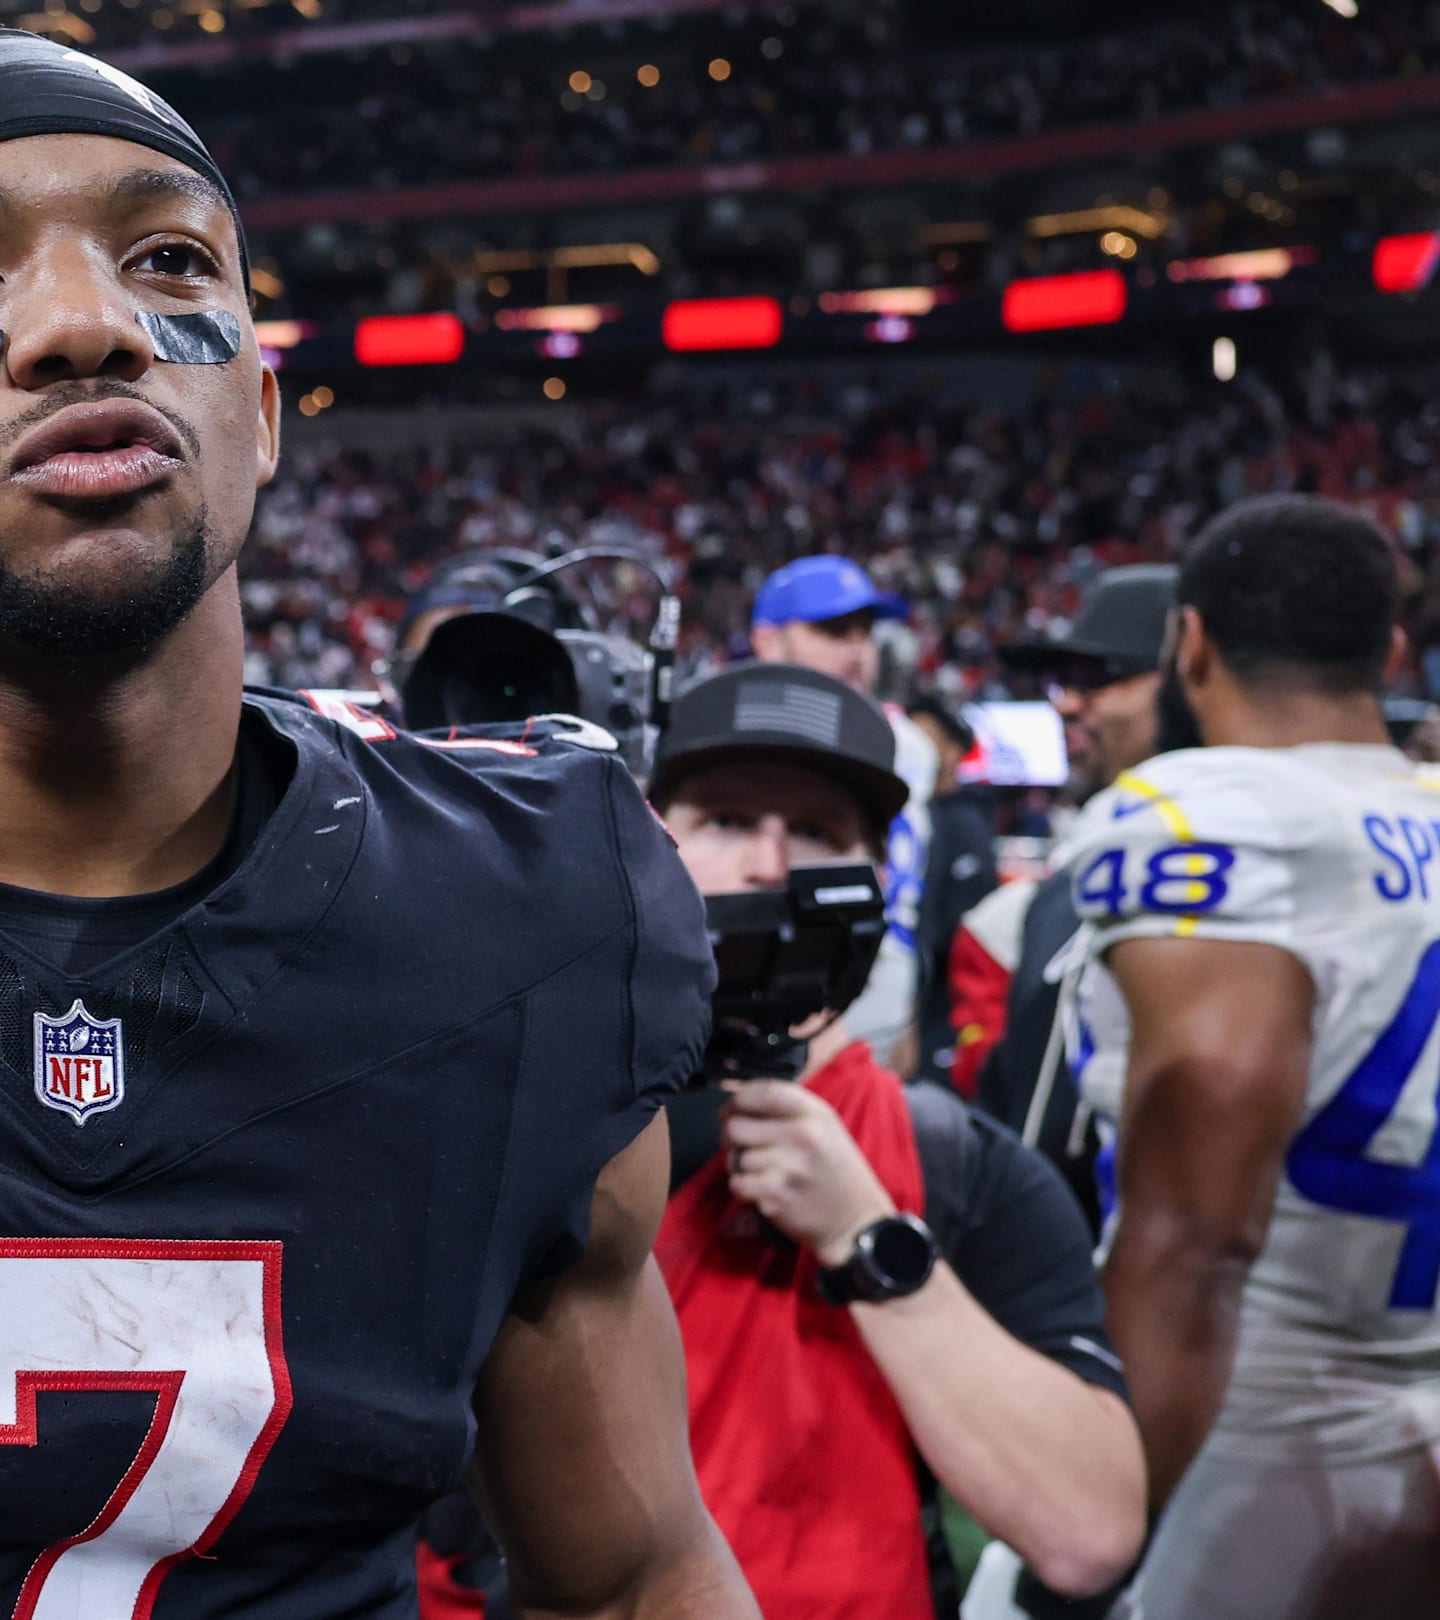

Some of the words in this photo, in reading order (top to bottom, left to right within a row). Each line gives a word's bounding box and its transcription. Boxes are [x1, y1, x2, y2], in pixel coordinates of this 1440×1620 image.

[1078, 841, 1236, 917] 48
[1362, 811, 1440, 904] SP
[49, 1056, 112, 1102] NFL
